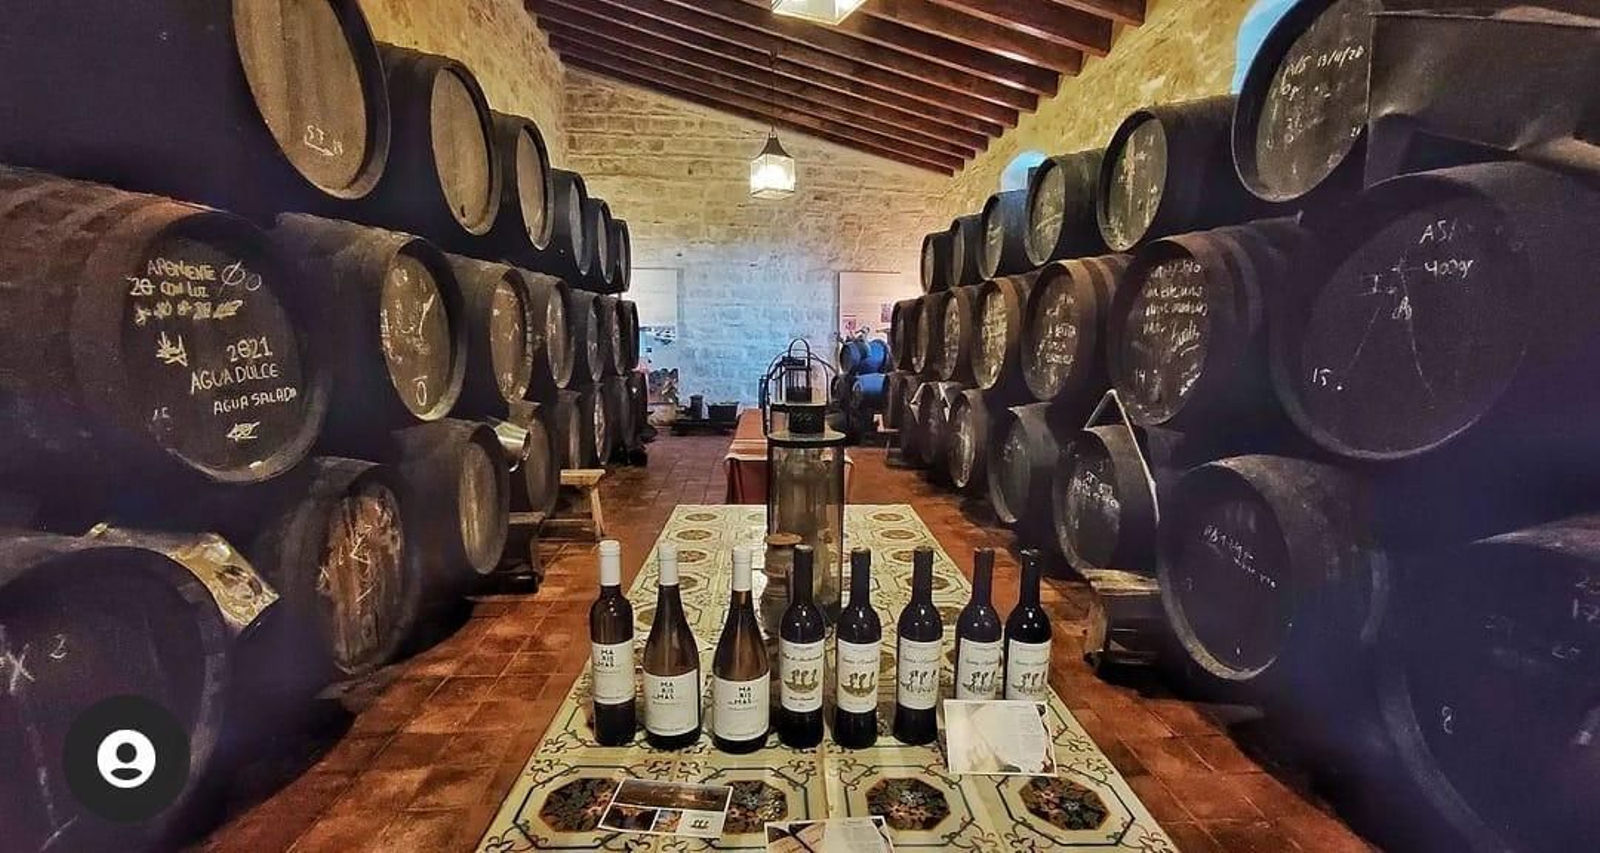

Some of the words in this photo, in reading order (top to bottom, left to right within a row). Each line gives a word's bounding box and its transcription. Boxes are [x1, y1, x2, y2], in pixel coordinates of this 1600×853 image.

[226, 336, 273, 362] 2021
[190, 368, 234, 395] AGUA
[234, 363, 279, 383] DULCE
[213, 396, 249, 415] AGUA
